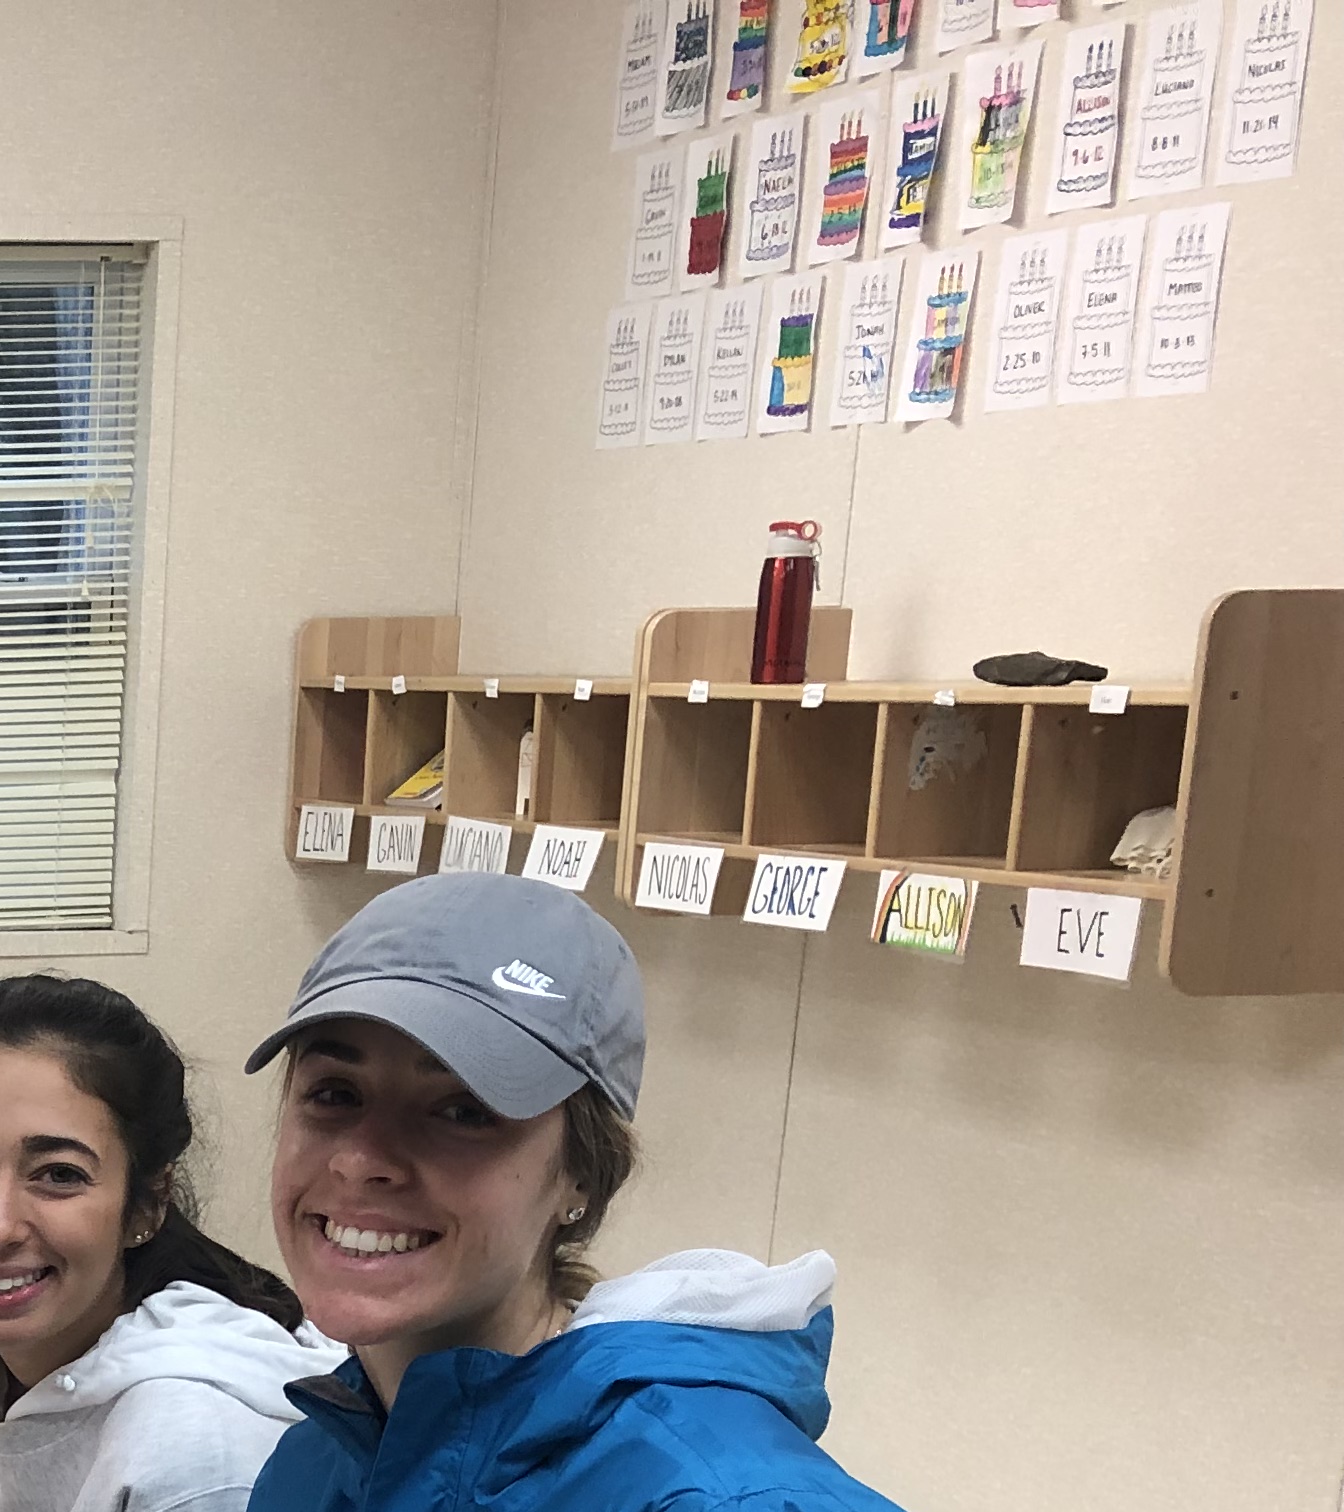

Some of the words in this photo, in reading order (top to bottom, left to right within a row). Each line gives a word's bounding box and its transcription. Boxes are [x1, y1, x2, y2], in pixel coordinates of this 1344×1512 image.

[302, 812, 345, 854] ELENA
[376, 822, 416, 864] GAVIN
[538, 840, 588, 879] NOAH
[647, 855, 711, 903] NICOLAS
[750, 862, 829, 922] GEORGE
[887, 884, 965, 936] ALLISON
[1057, 904, 1110, 959] EVE
[505, 959, 555, 993] NIKE
